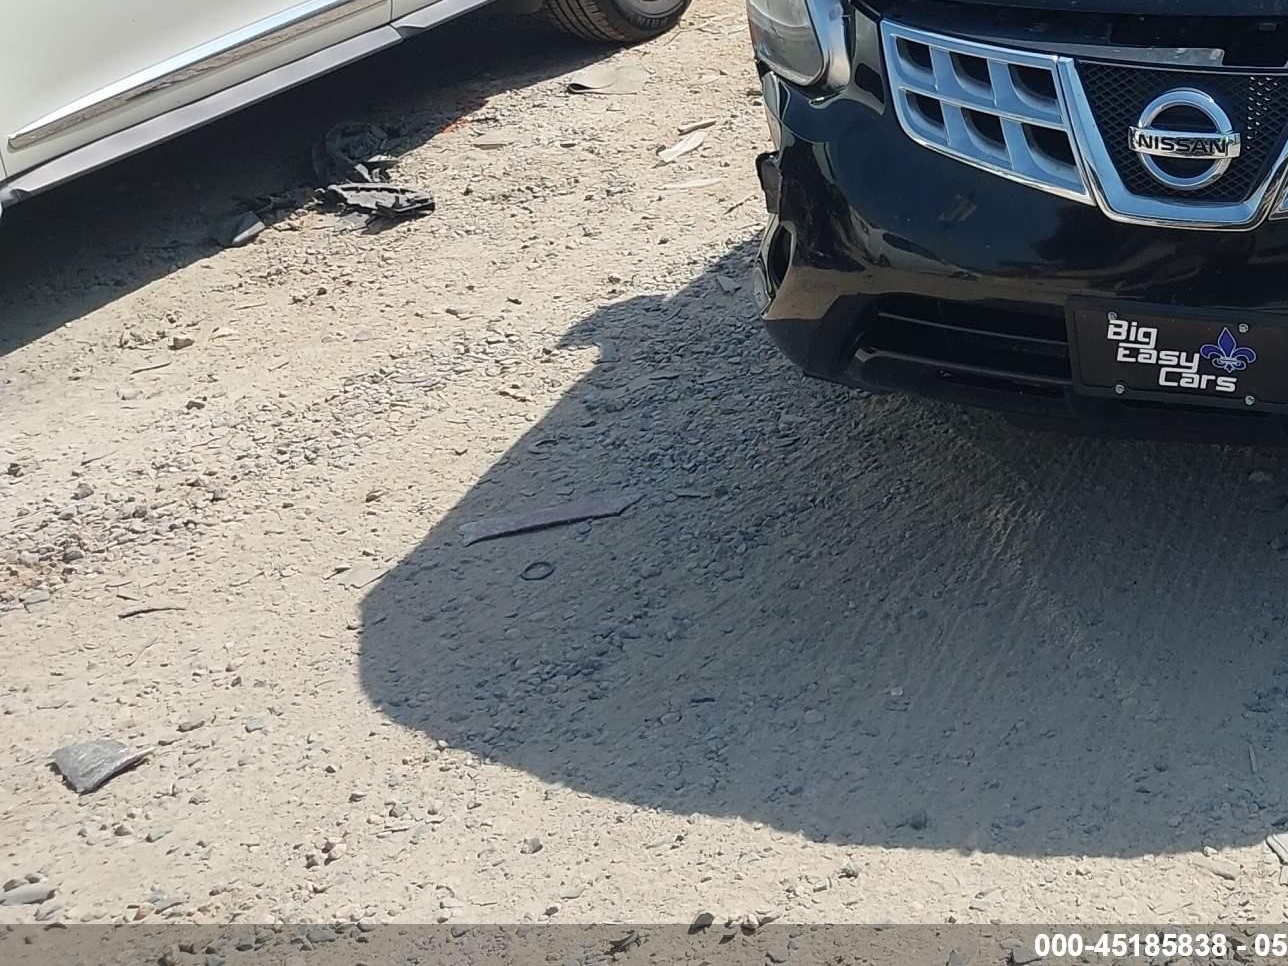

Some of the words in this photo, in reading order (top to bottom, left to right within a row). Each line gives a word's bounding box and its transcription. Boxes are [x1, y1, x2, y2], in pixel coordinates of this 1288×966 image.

[1137, 134, 1227, 154] NISSAN
[1107, 319, 1158, 349] Big
[1116, 342, 1200, 373] Easy
[1158, 367, 1238, 392] Cars
